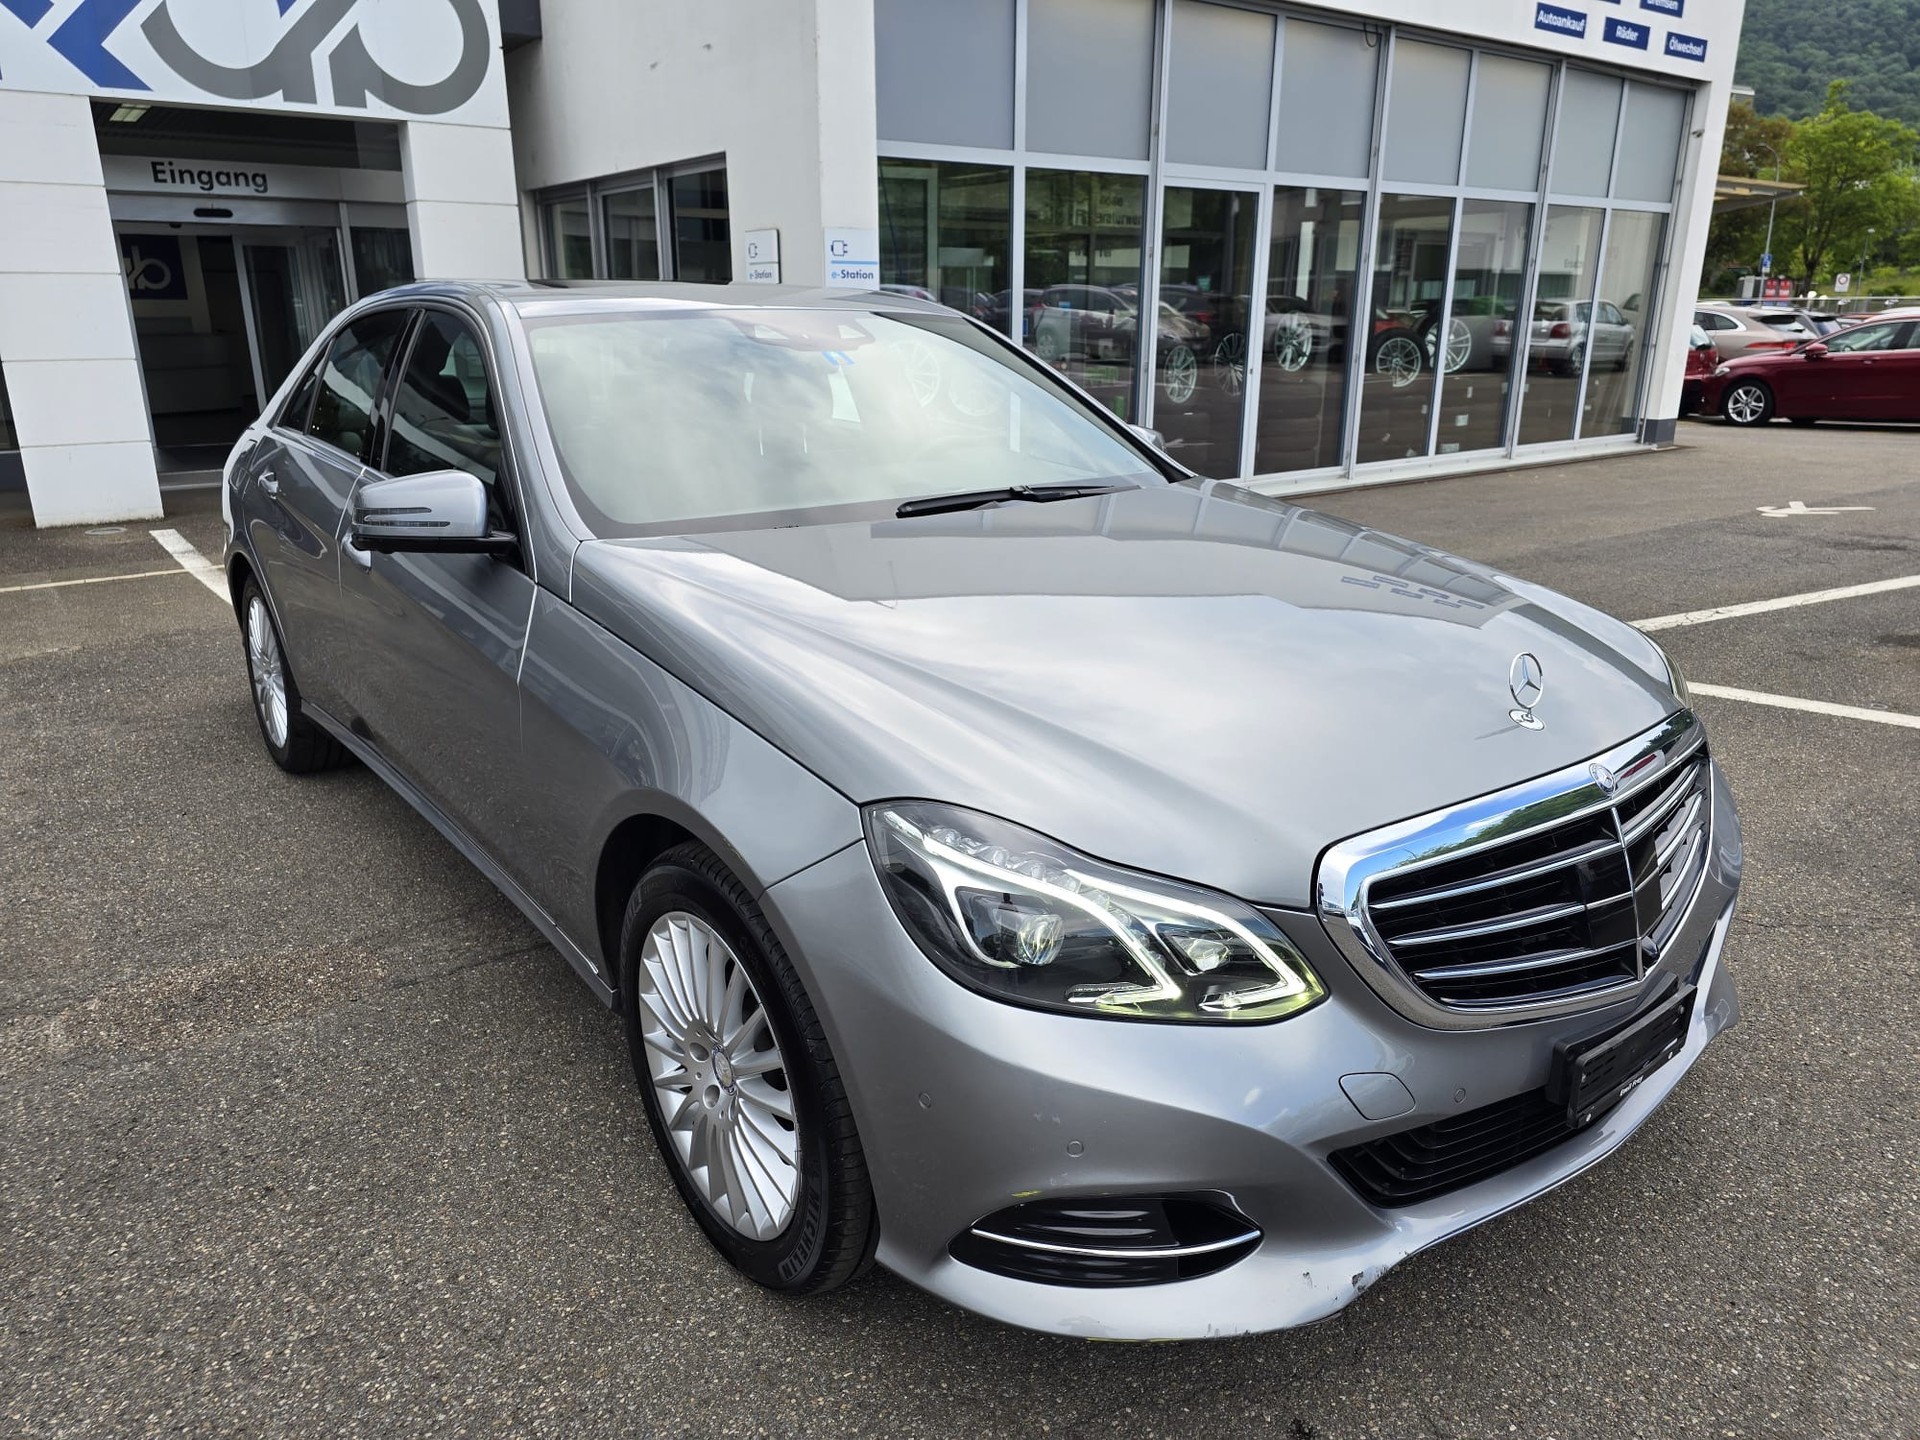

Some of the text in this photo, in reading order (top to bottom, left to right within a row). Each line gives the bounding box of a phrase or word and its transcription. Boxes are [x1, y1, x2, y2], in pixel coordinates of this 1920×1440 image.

[1538, 10, 1585, 32] Autoankauf
[1615, 25, 1638, 41] Räder
[1669, 36, 1703, 56] Ölwechsel
[150, 160, 268, 194] Eingang
[831, 269, 874, 280] e-Station
[781, 1184, 820, 1279] MICHELIN
